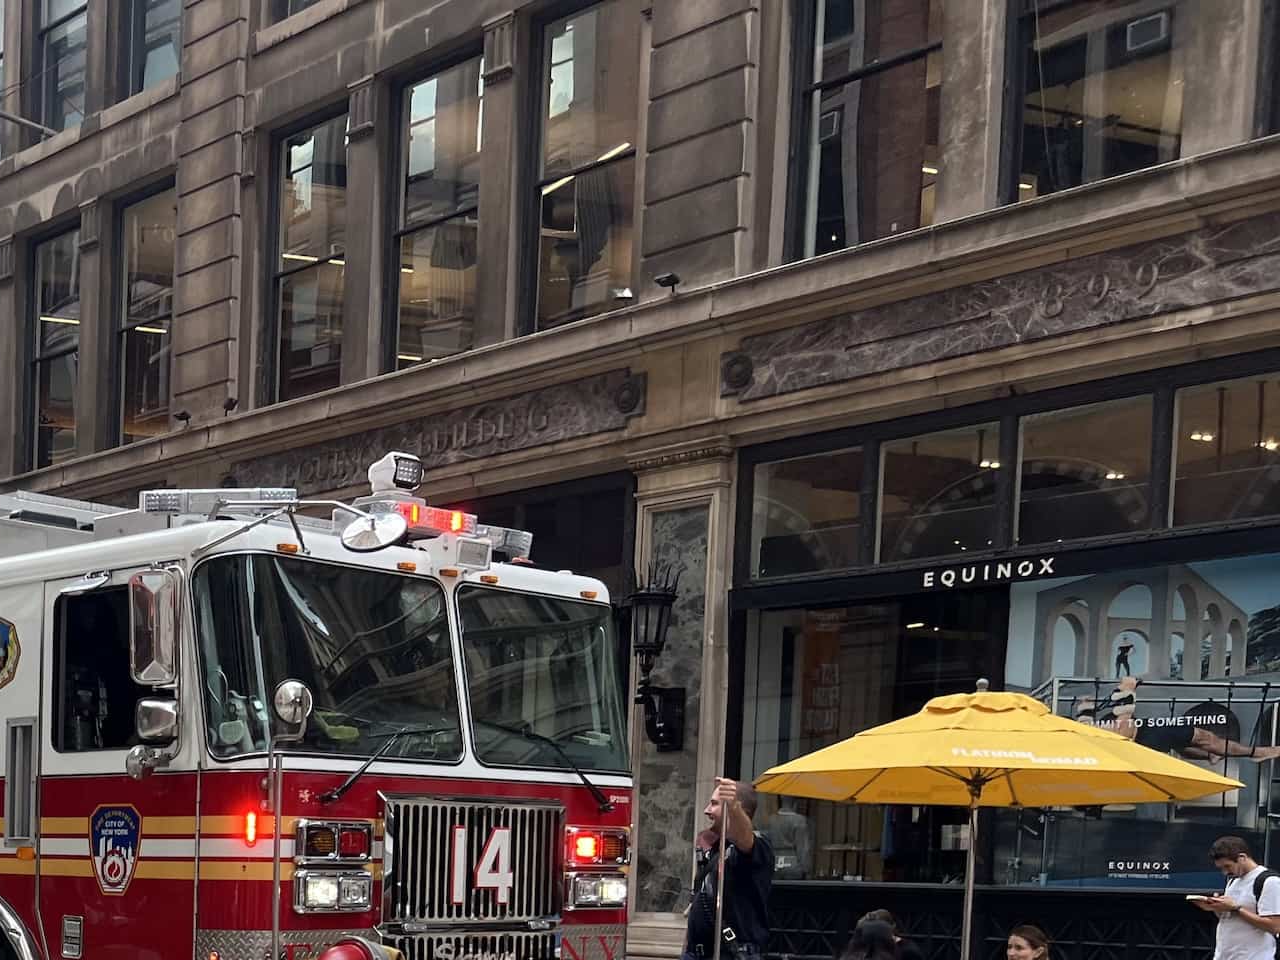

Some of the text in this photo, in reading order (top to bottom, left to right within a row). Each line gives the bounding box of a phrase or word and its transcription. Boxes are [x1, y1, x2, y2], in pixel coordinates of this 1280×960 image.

[922, 557, 1055, 588] EQUINOX
[1127, 718, 1144, 728] TO
[1147, 714, 1227, 728] SOMETHING
[114, 828, 129, 836] YORK
[450, 825, 513, 905] 14
[1108, 861, 1170, 871] EQUINOX
